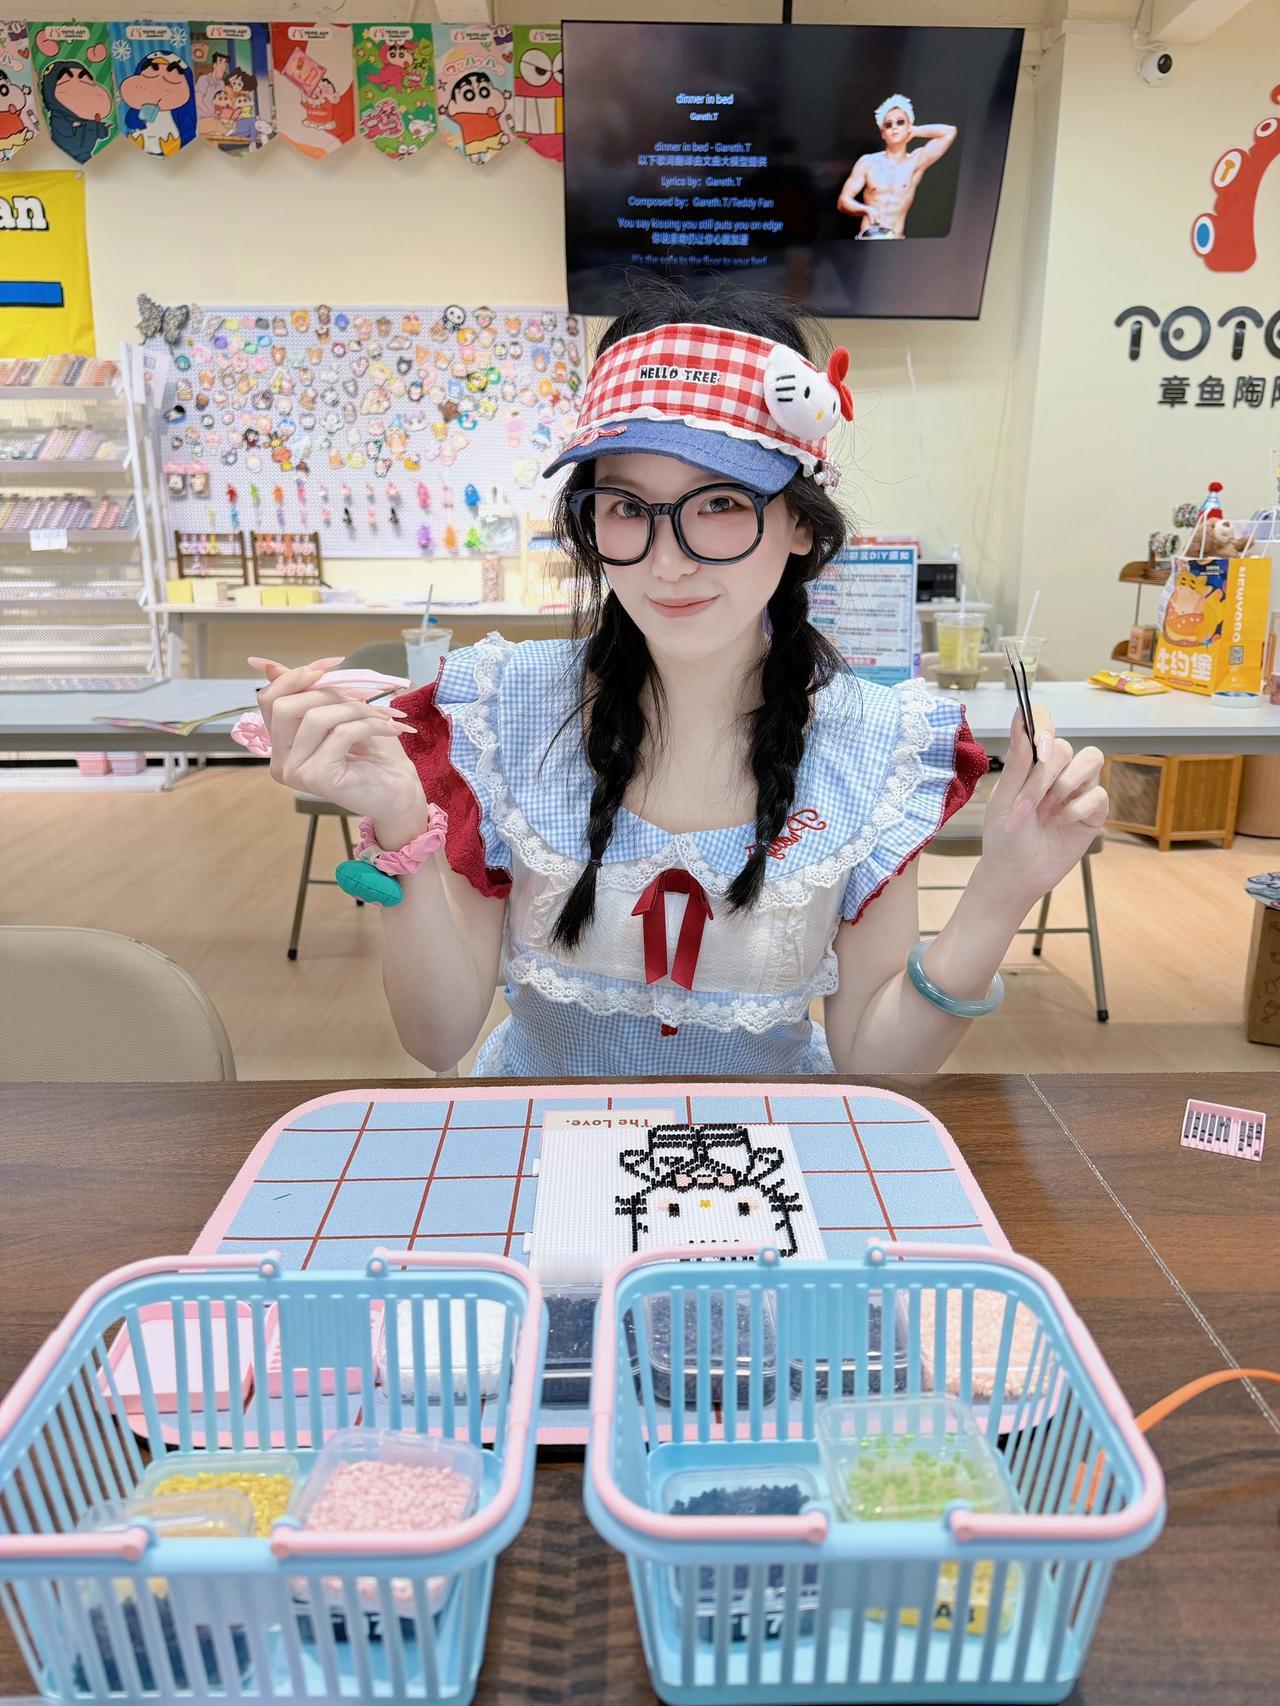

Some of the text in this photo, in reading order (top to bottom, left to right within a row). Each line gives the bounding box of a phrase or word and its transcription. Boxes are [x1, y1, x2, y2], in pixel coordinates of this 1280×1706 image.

[705, 93, 715, 105] in
[716, 93, 734, 105] bed
[682, 142, 691, 152] in
[692, 142, 709, 152] bed
[628, 196, 673, 209] Composed
[617, 217, 634, 228] You
[635, 219, 650, 231] say
[682, 220, 697, 231] you
[733, 221, 749, 231] you
[762, 219, 783, 232] edge
[640, 366, 679, 380] HELLO
[618, 1118, 649, 1129] The
